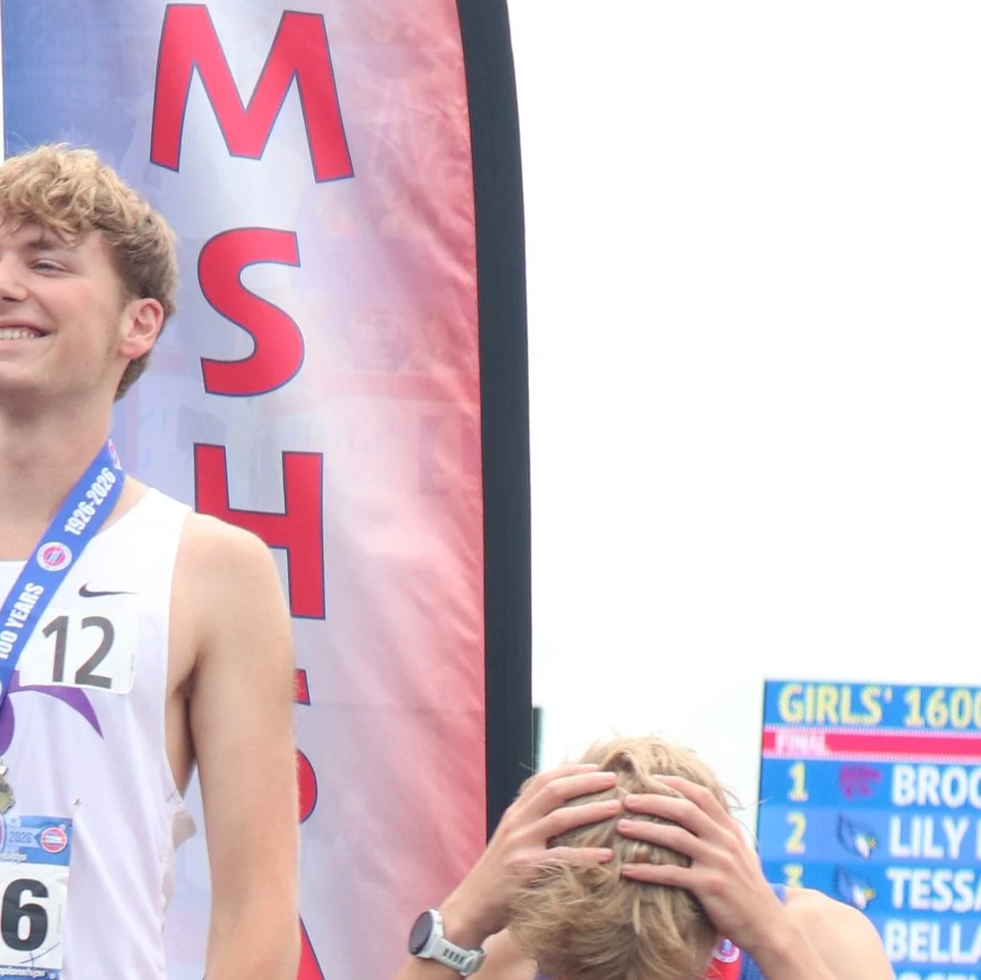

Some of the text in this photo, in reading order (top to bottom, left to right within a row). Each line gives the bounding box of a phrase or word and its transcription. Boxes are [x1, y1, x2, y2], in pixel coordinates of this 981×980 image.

[64, 467, 117, 536] 1926-2026
[4, 582, 45, 629] YEARS
[42, 614, 116, 689] 12
[778, 683, 894, 726] GIRLS'
[788, 760, 809, 802] 1
[785, 811, 807, 855] 2
[888, 815, 969, 860] LILY
